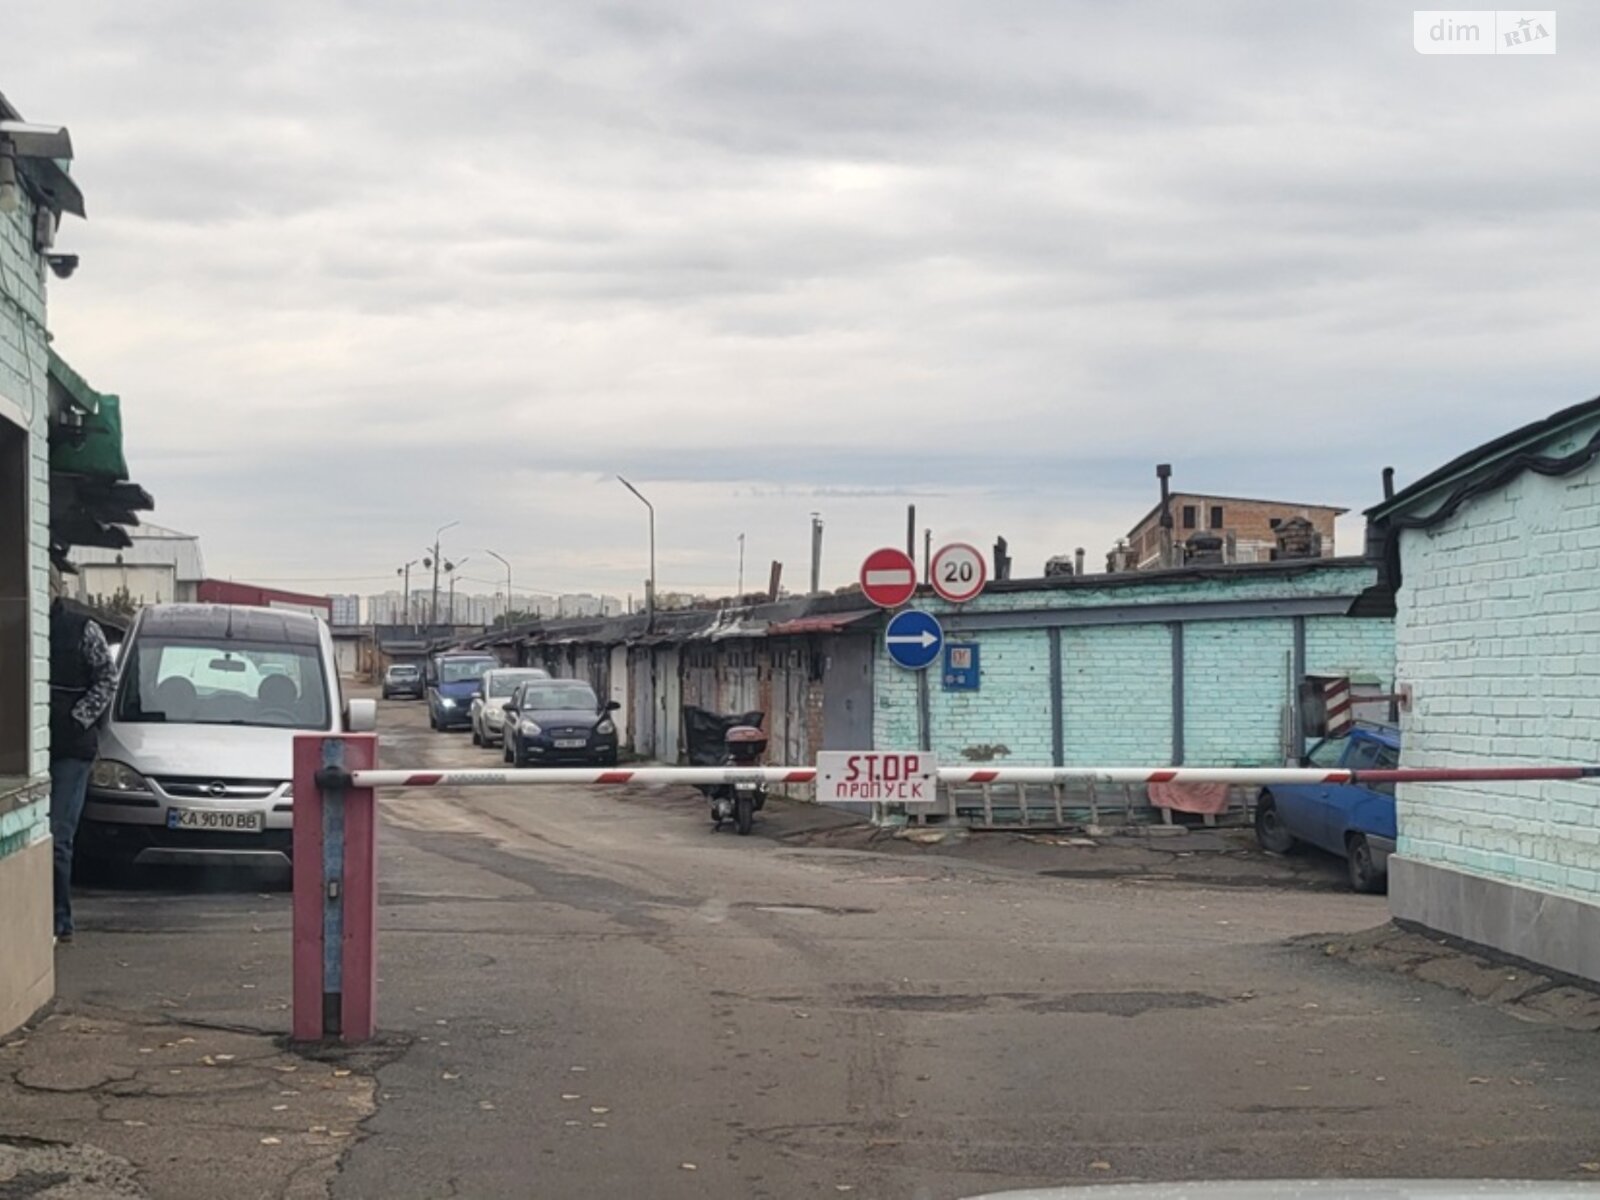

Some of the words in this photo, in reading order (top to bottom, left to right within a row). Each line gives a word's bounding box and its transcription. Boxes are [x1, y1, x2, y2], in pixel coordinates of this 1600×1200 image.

[945, 561, 972, 582] 20
[845, 755, 919, 782] STOP
[836, 783, 922, 798] ПРОПУСК
[202, 813, 234, 827] 9010
